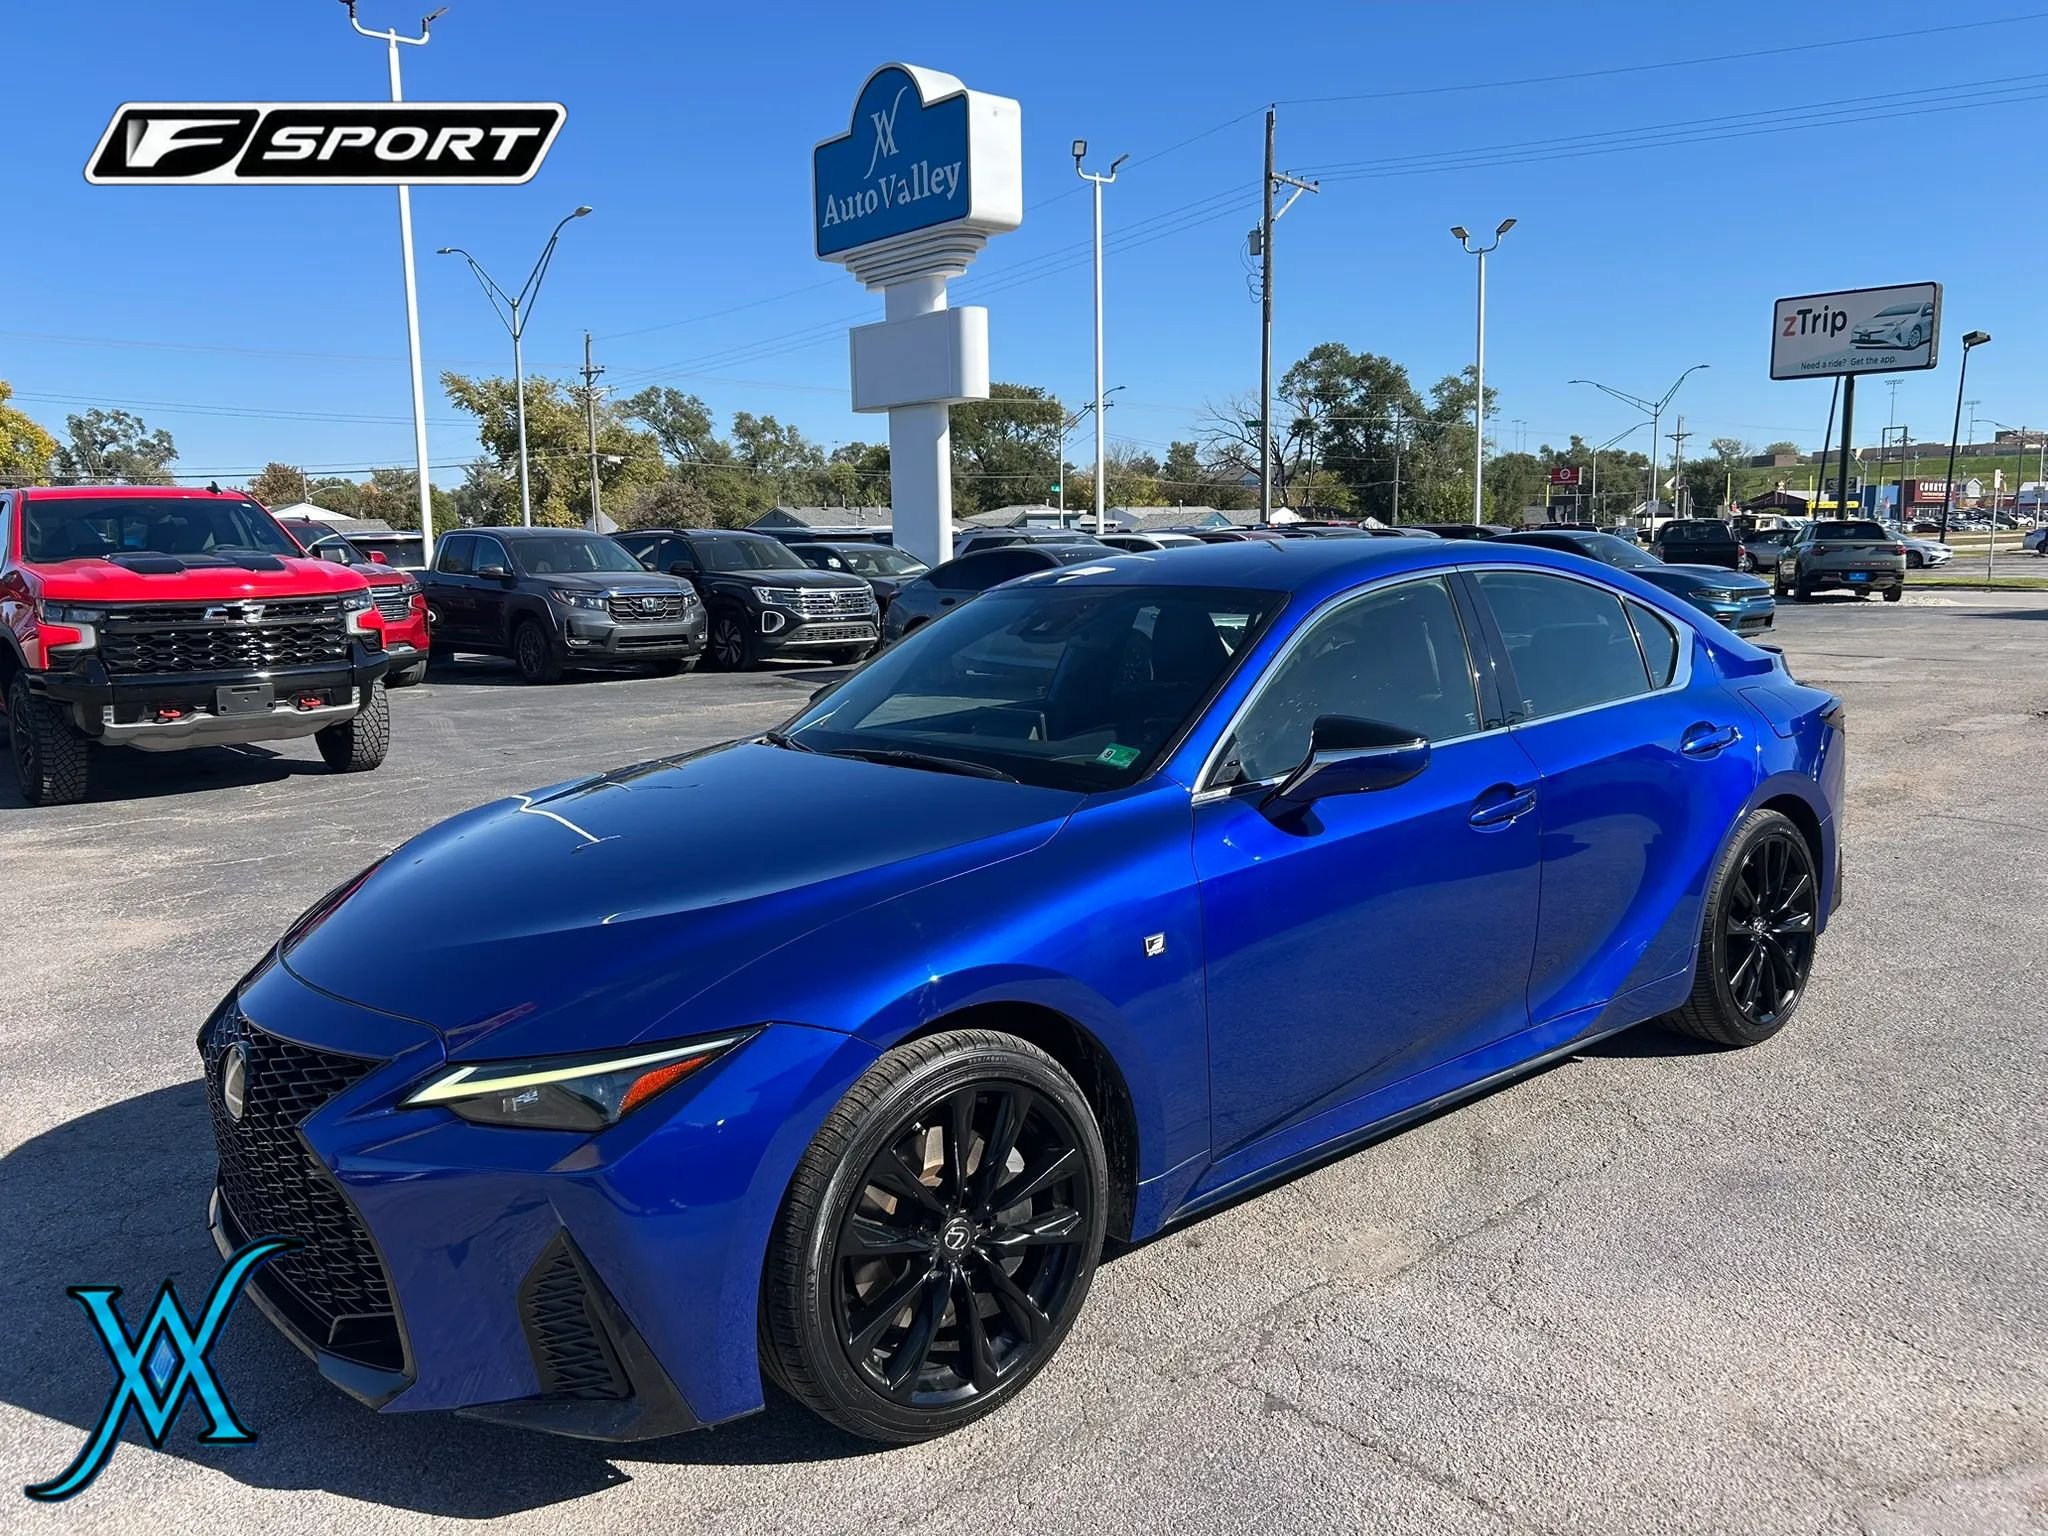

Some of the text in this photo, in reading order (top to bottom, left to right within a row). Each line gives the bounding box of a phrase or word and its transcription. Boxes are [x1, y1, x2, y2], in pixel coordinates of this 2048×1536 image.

[1782, 304, 1848, 338] zTrip
[1801, 361, 1820, 370] Need
[1828, 358, 1847, 368] ride?
[1850, 357, 1864, 366] Get
[1865, 356, 1878, 365] the
[1919, 482, 1955, 492] COURTEY
